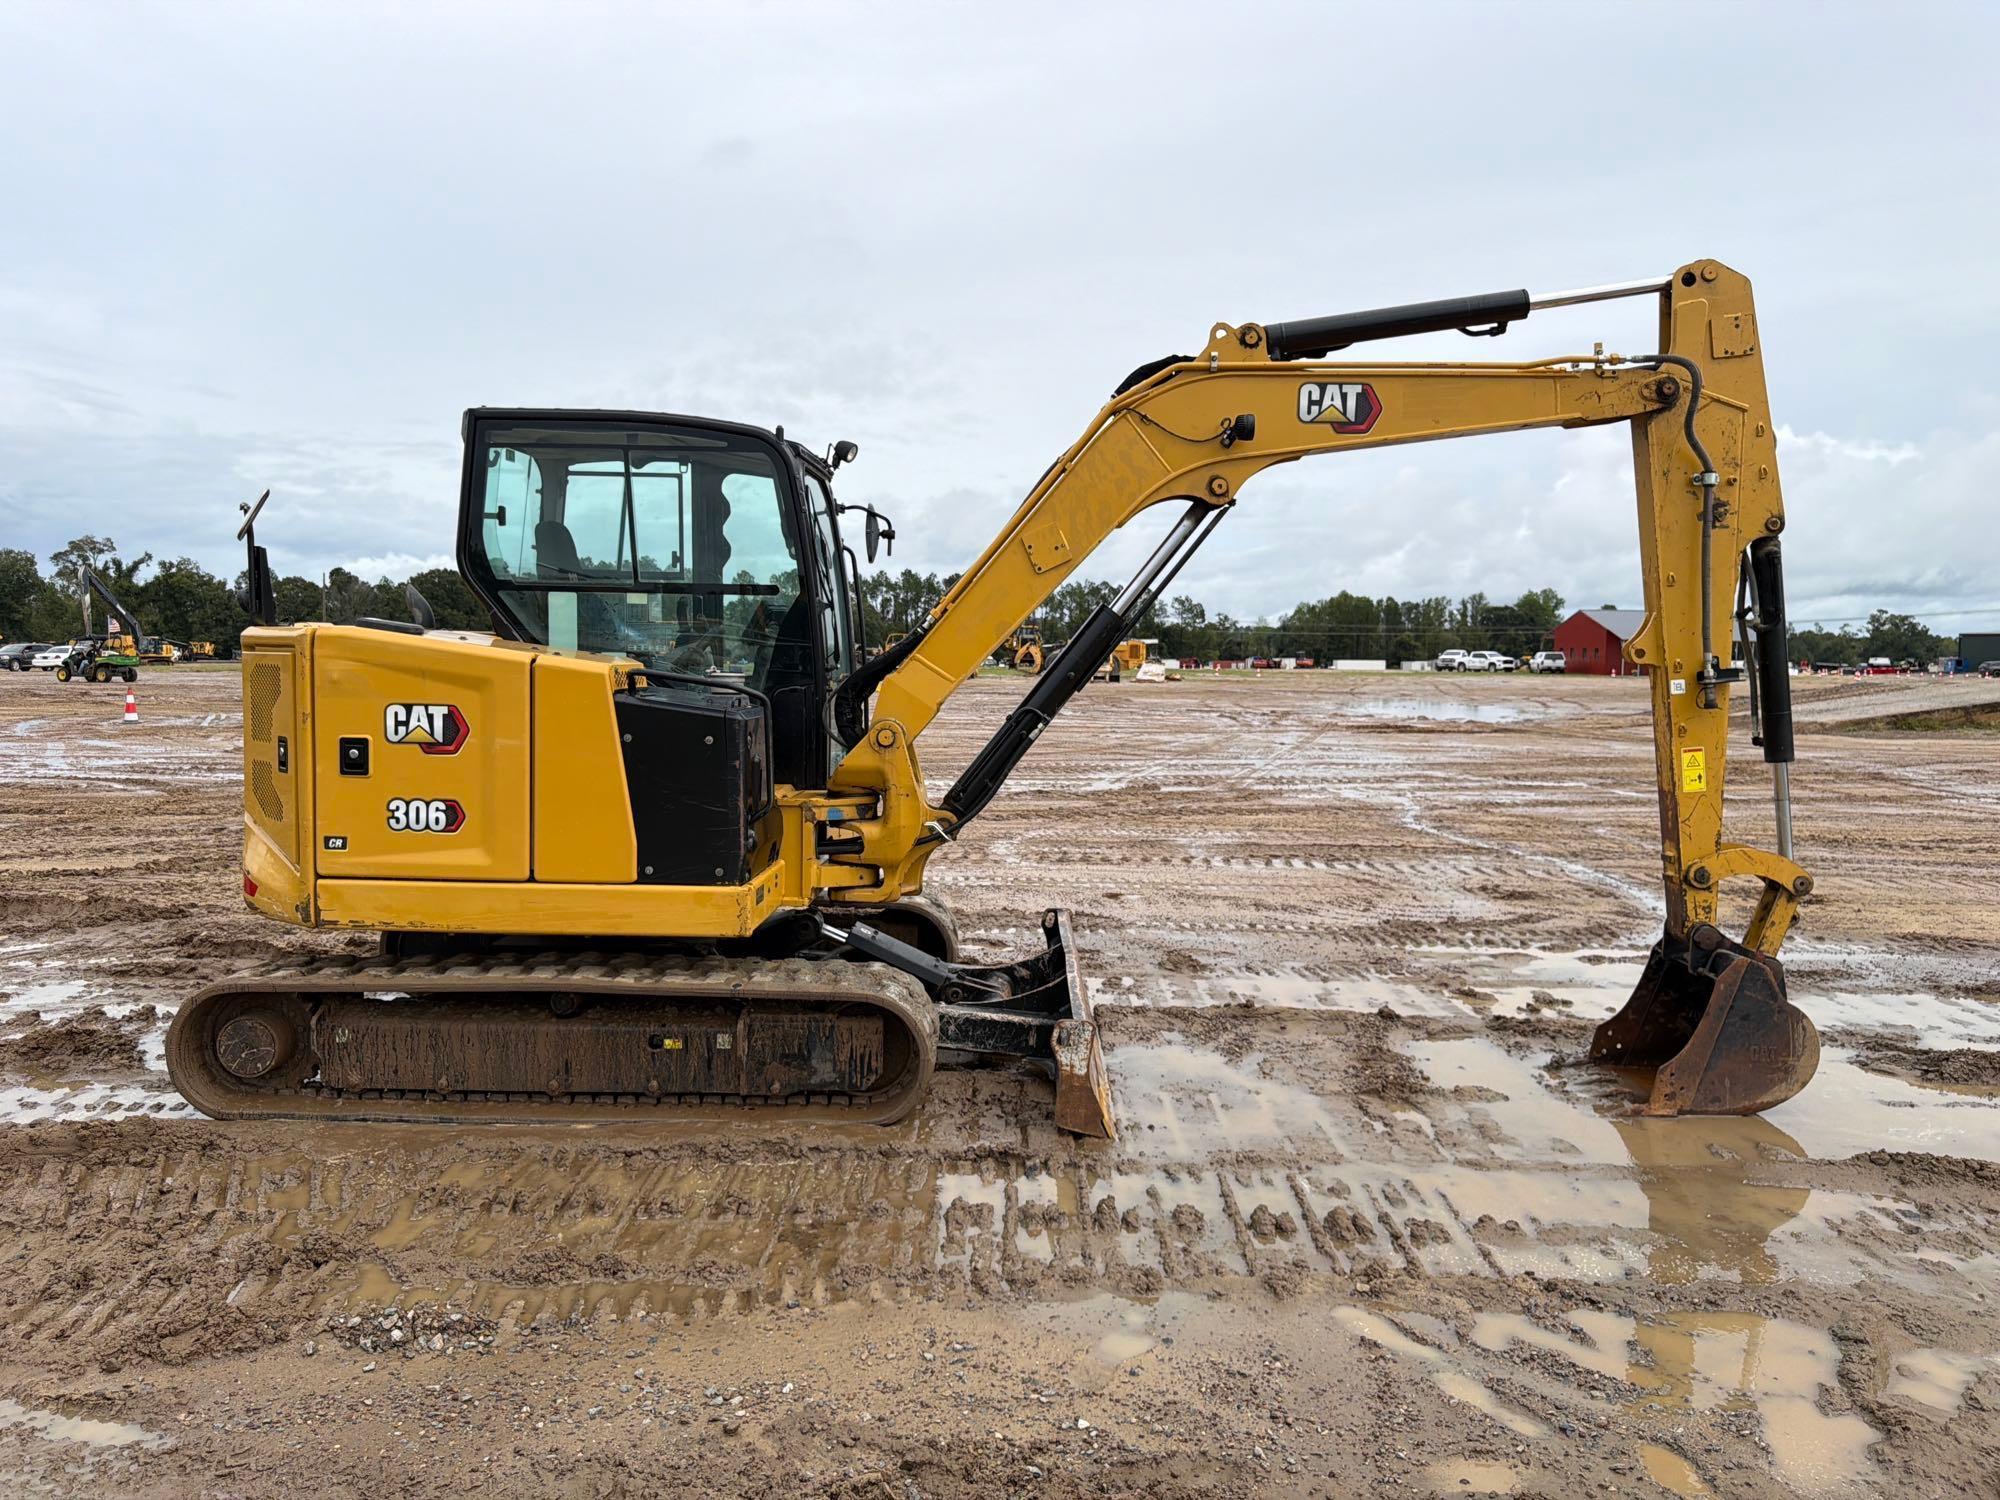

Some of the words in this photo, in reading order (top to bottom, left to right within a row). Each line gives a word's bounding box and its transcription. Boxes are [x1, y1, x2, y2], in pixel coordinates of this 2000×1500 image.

[1299, 383, 1363, 422] CAT
[385, 704, 449, 743] CAT
[388, 799, 447, 831] 306
[328, 838, 343, 848] CR
